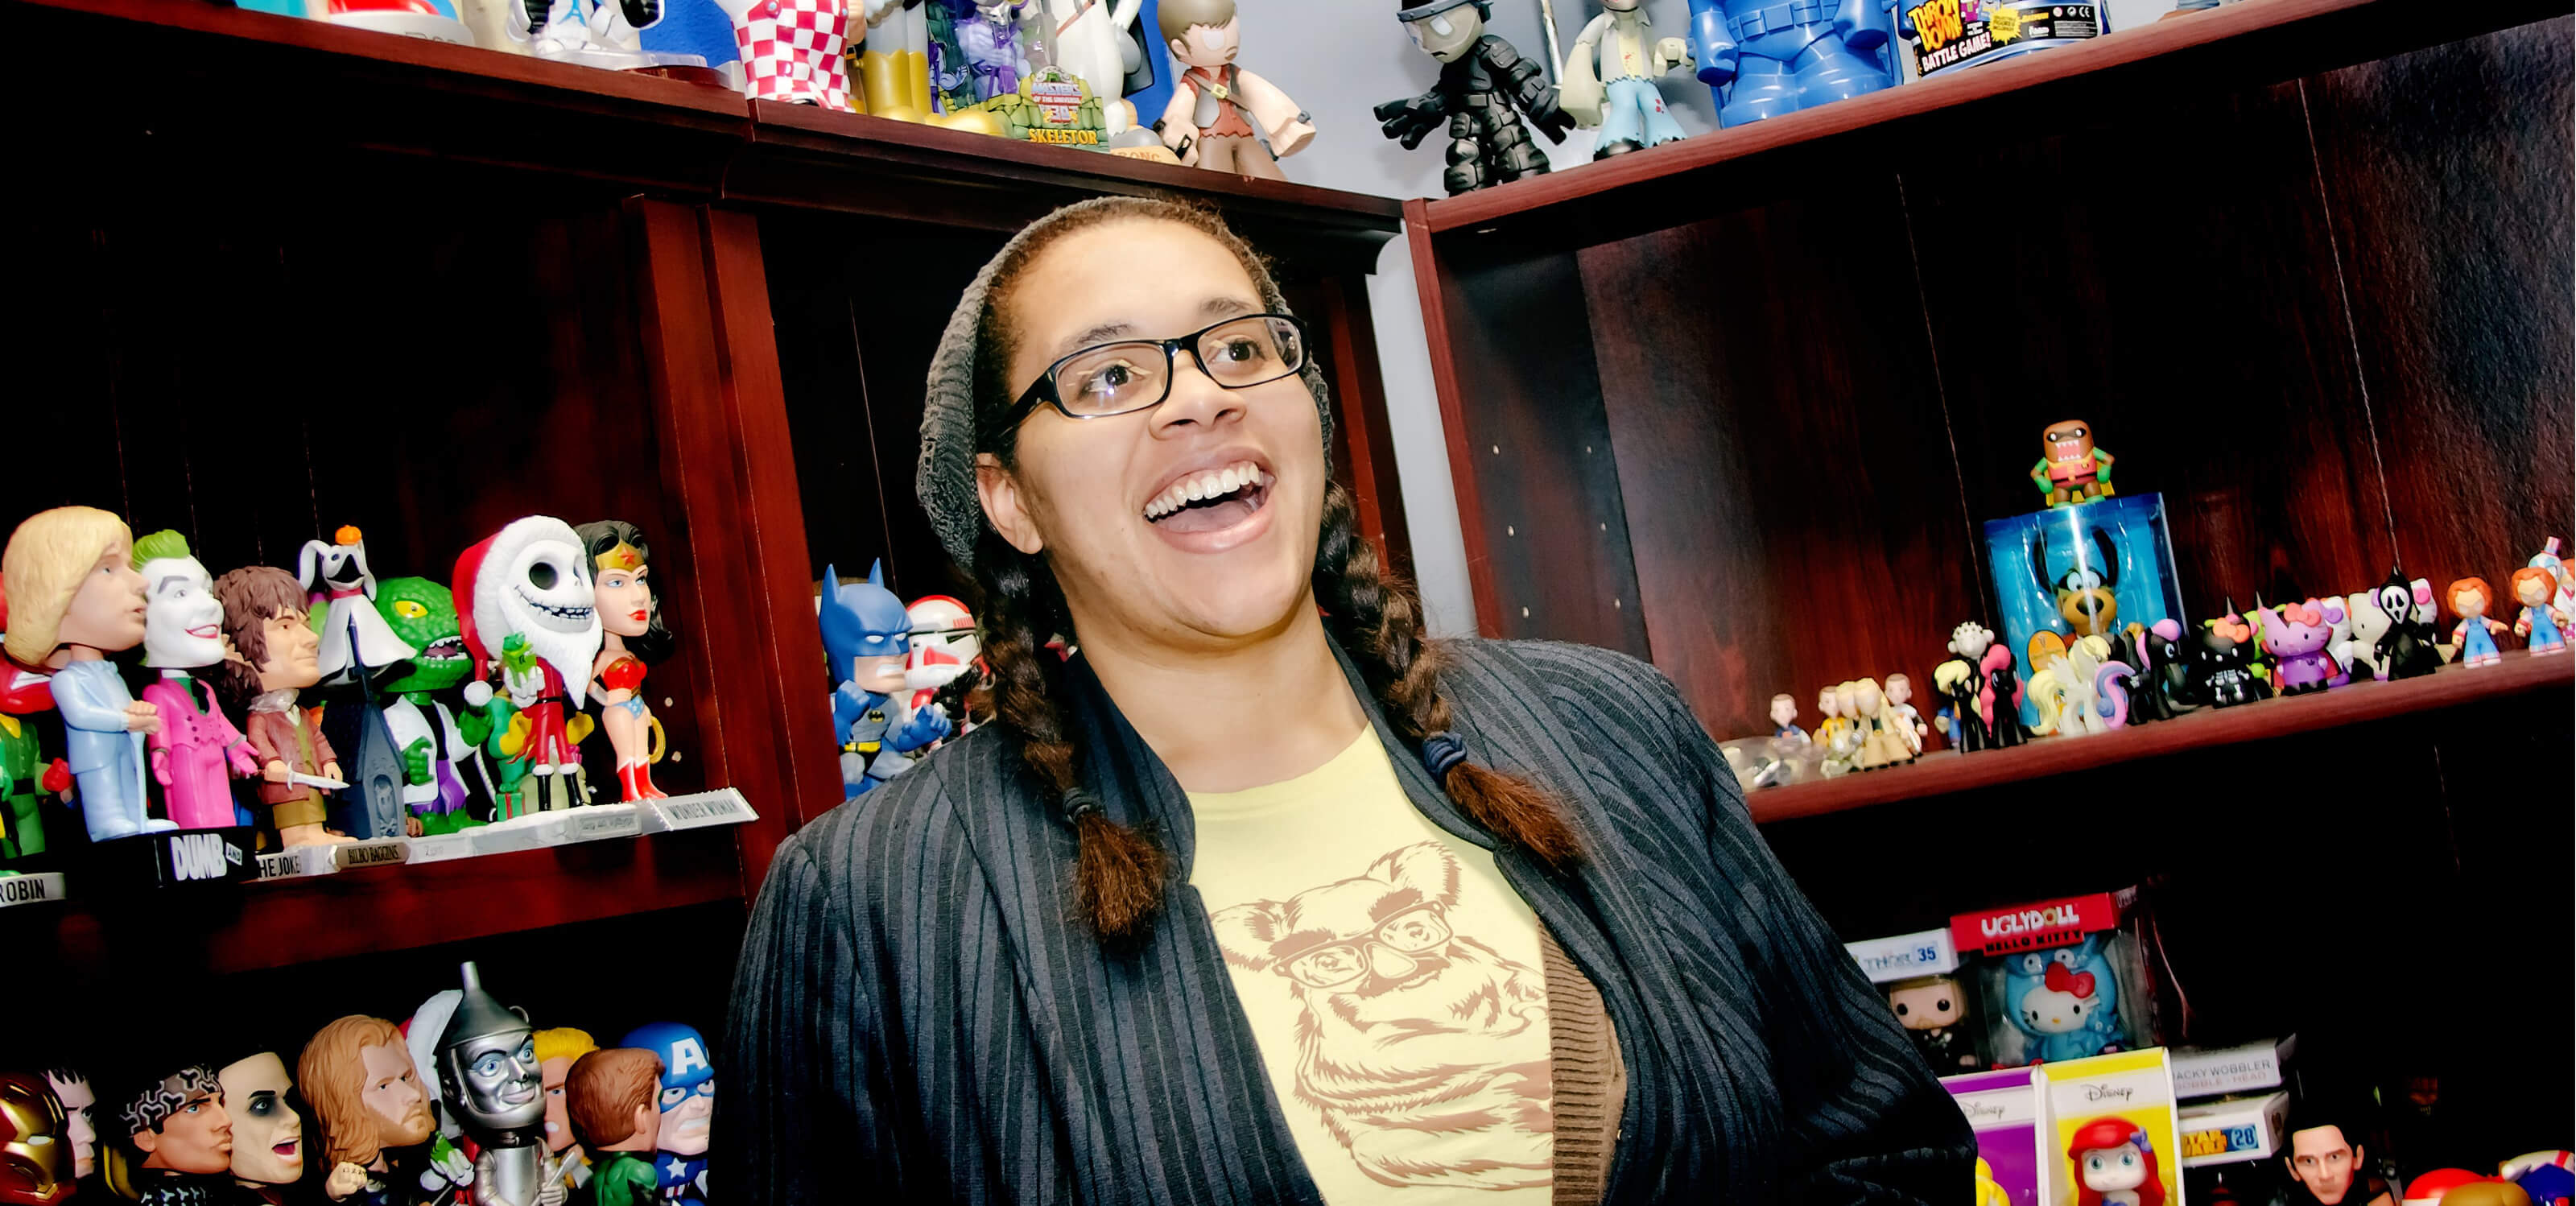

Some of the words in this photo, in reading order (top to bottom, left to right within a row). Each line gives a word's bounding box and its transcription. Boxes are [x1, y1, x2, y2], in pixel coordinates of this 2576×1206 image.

[1922, 45, 1959, 72] BATTLE
[1958, 31, 1992, 57] GAME!
[1028, 128, 1098, 145] SKELETOR
[169, 832, 228, 882] DUMB
[228, 847, 241, 862] AND
[347, 848, 369, 864] BILBO
[258, 858, 277, 878] HE
[278, 856, 301, 876] JOKE
[1981, 904, 2079, 937] UGLYDOLL
[1985, 937, 2030, 952] HELLO
[2037, 930, 2083, 944] KITTY
[1917, 946, 1937, 962] 35
[2173, 1068, 2207, 1080] ACKY
[2209, 1059, 2271, 1076] WOBBLER
[2081, 1084, 2134, 1101] Disney
